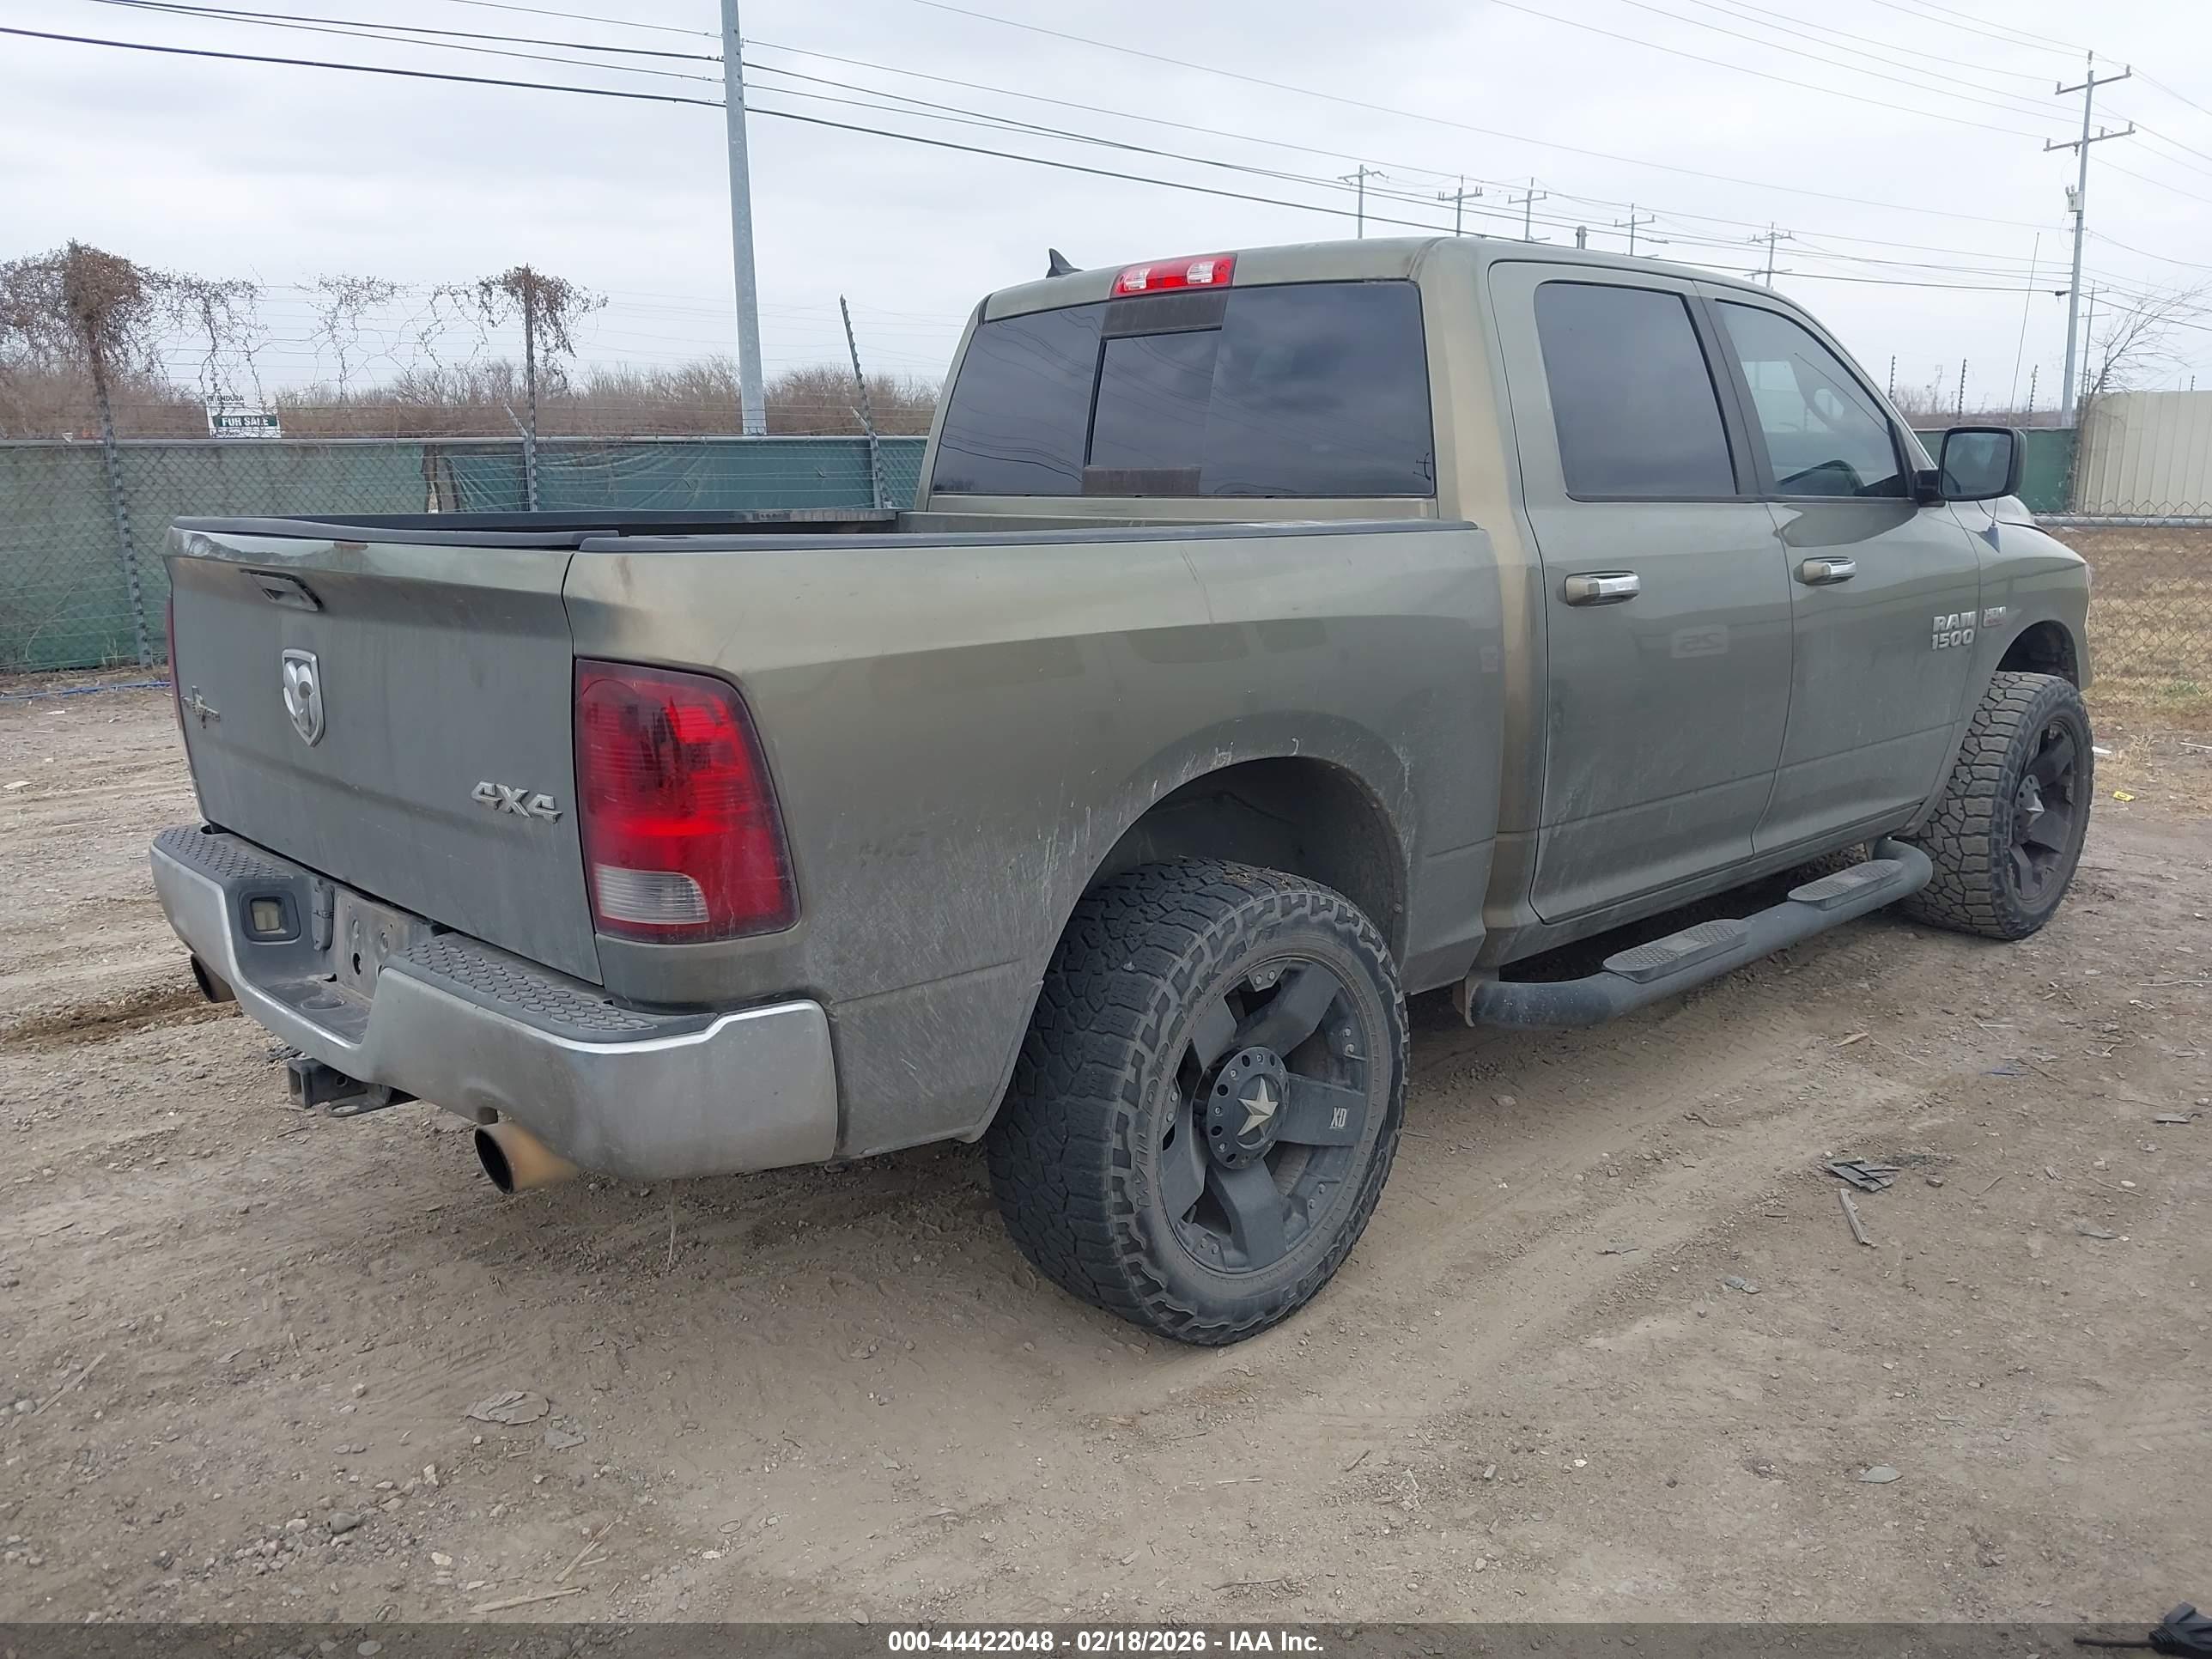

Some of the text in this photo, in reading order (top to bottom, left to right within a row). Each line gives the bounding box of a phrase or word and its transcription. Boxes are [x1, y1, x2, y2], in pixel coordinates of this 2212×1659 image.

[244, 416, 269, 427] SALE
[1933, 611, 1976, 633] RAM
[1931, 629, 1974, 650] 1500
[1330, 1107, 1348, 1128] XD
